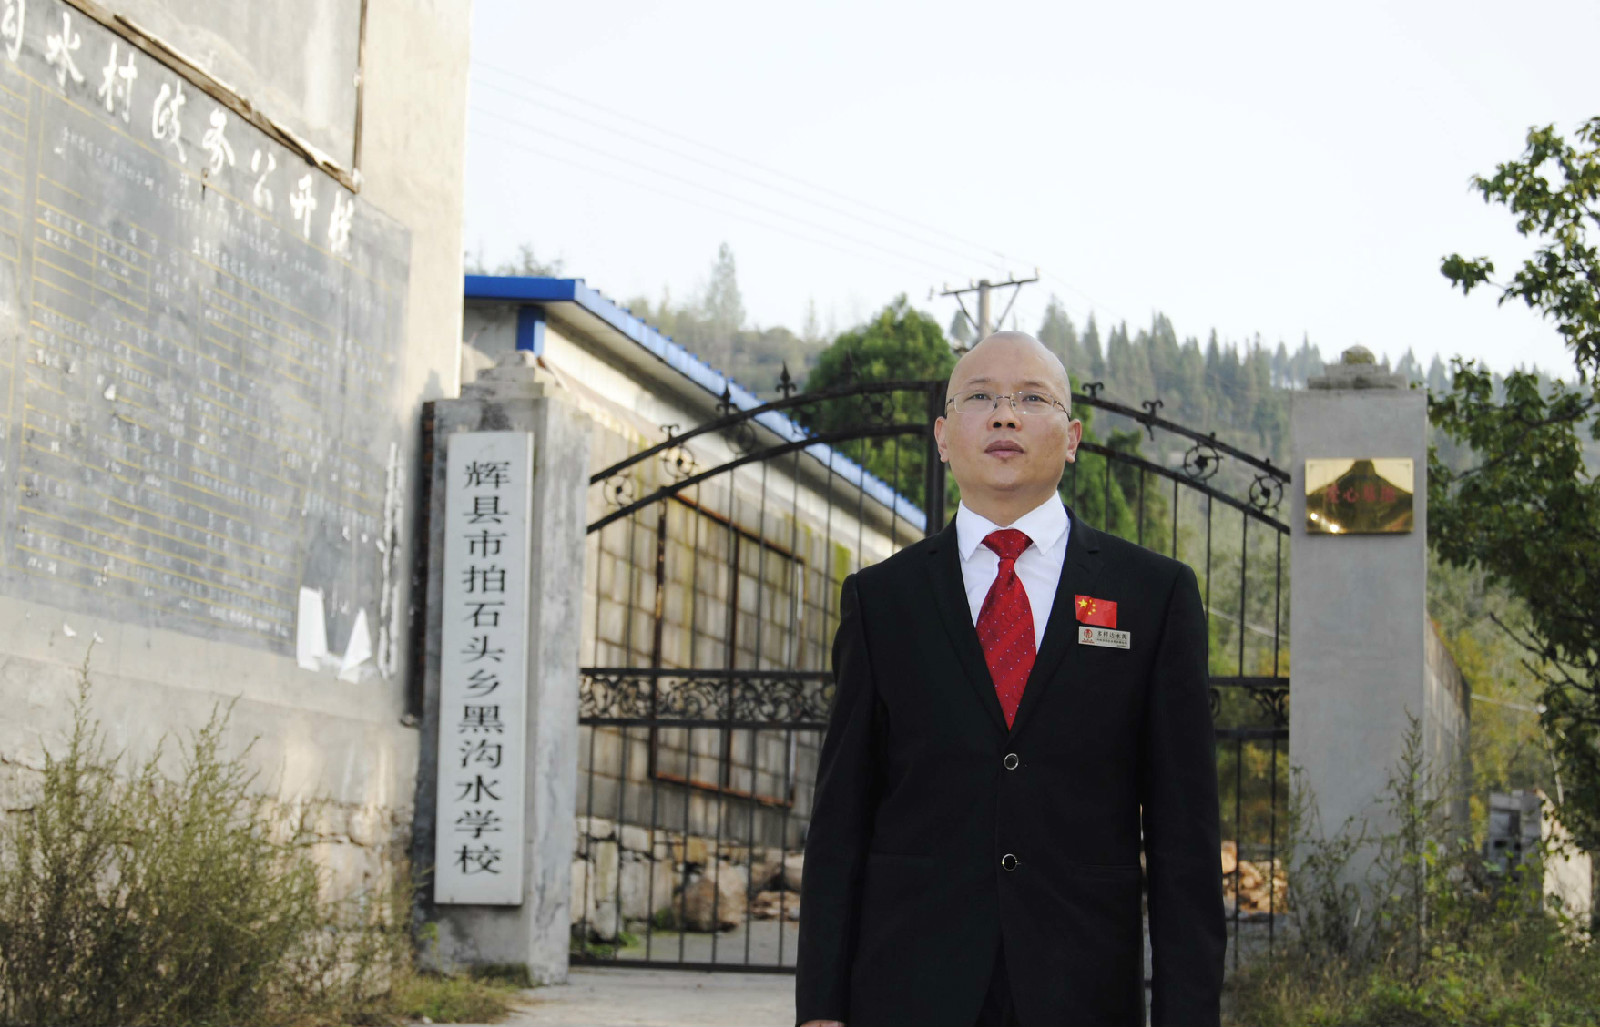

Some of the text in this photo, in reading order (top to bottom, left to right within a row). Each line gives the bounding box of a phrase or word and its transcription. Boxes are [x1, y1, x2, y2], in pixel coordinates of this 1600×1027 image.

[453, 459, 512, 876] 辉县市拍石头乡黑沟水学校
